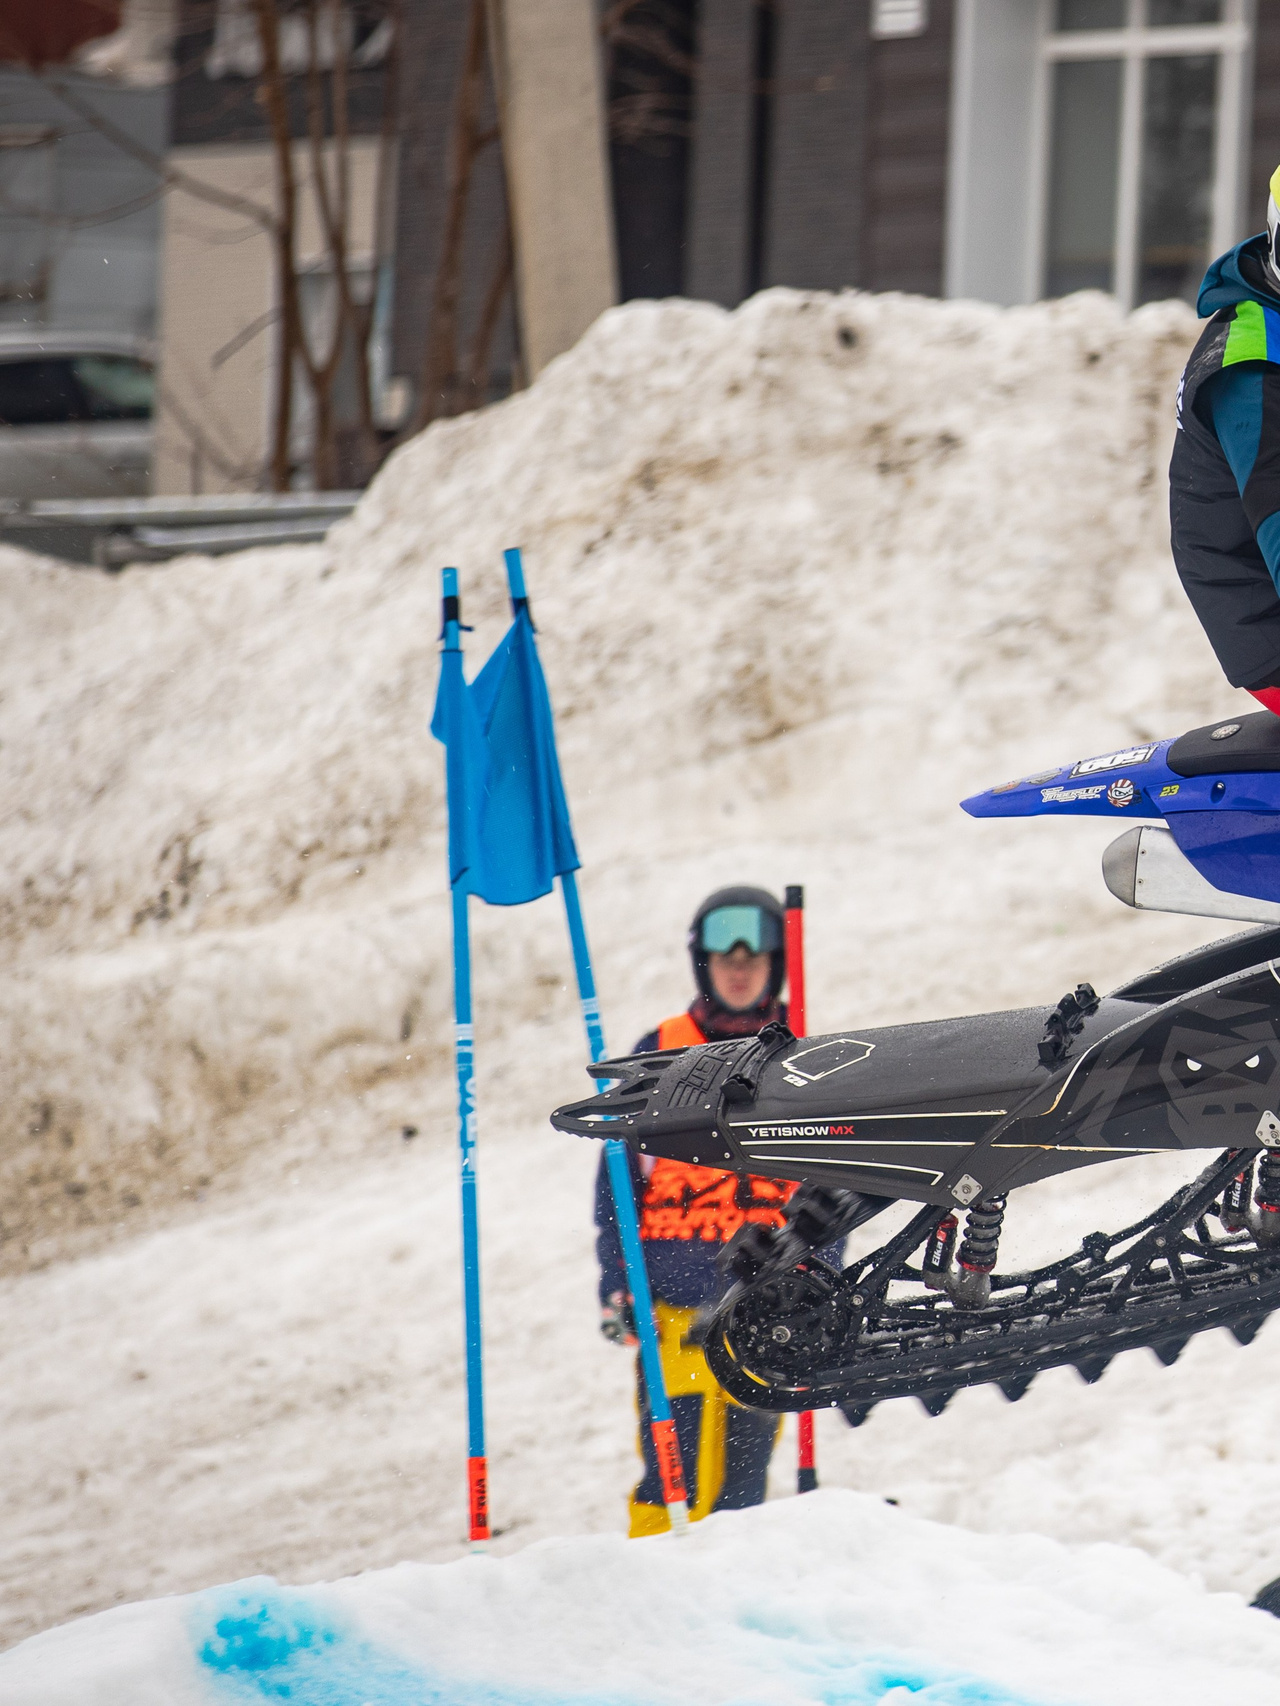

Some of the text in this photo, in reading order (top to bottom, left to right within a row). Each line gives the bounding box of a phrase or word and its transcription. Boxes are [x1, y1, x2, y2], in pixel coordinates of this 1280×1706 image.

[1159, 785, 1180, 798] 23
[1231, 1182, 1242, 1208] Elka
[931, 1240, 944, 1267] Elka
